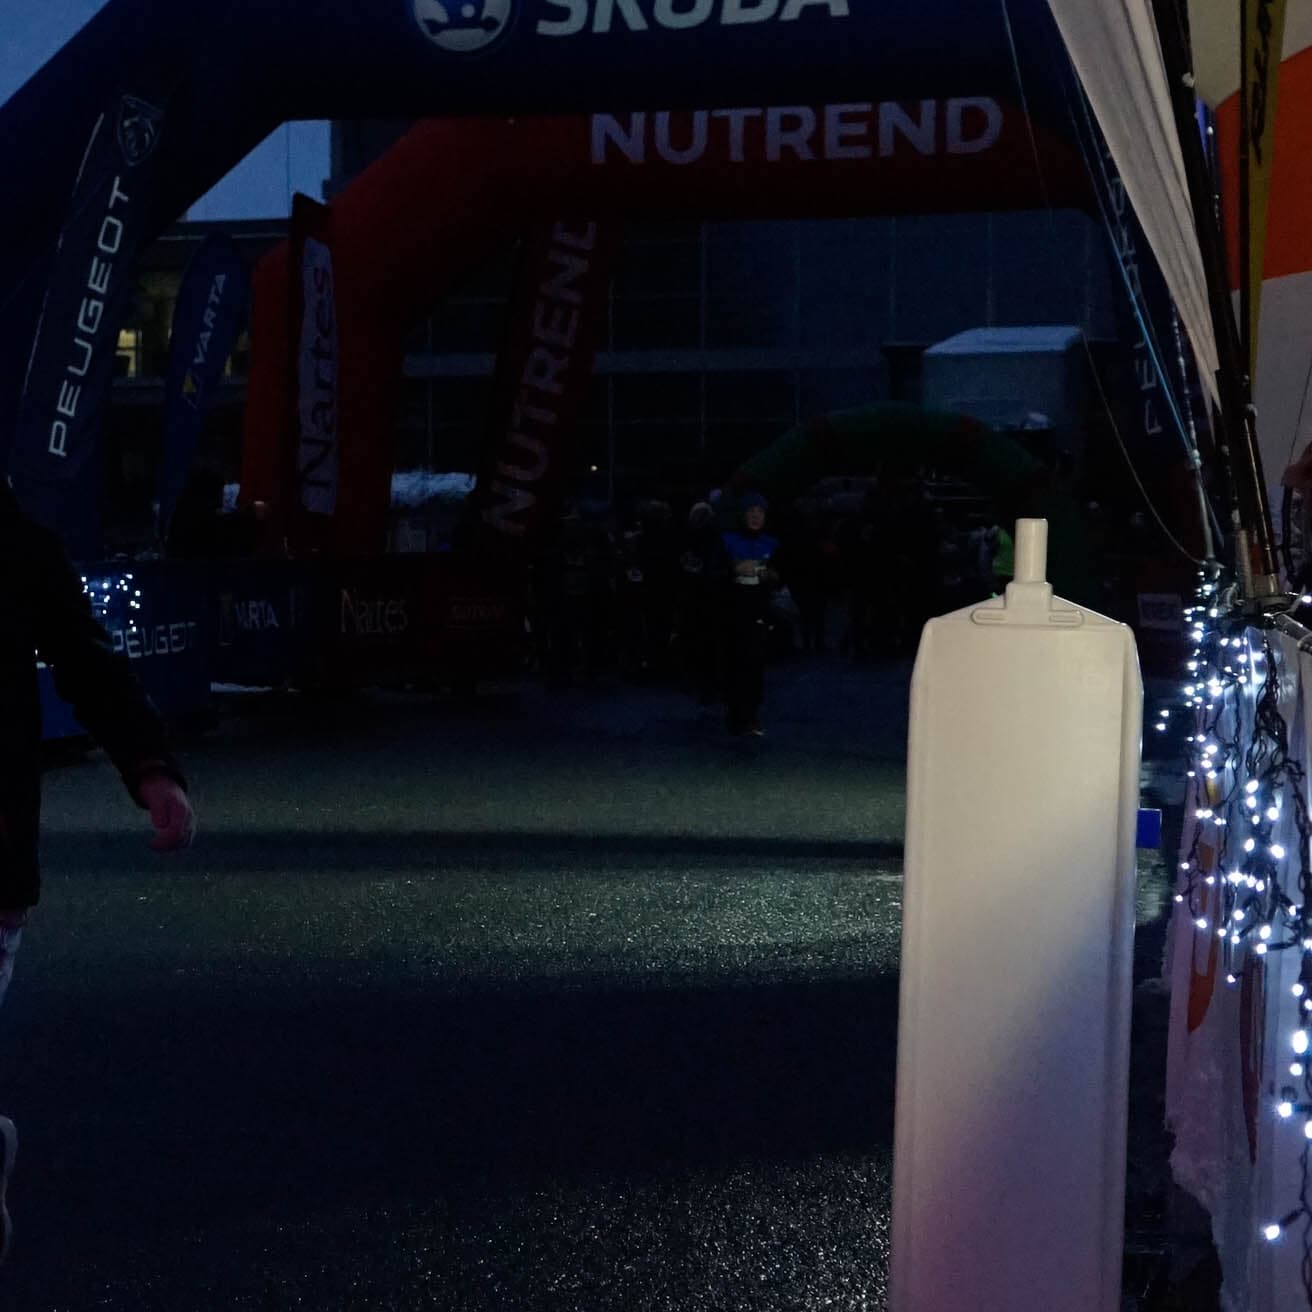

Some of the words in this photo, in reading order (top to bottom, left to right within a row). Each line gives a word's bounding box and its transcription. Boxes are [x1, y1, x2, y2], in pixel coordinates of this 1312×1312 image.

[588, 96, 1004, 166] NUTREND
[48, 174, 136, 459] PEUGEOT
[193, 273, 227, 365] VARTA
